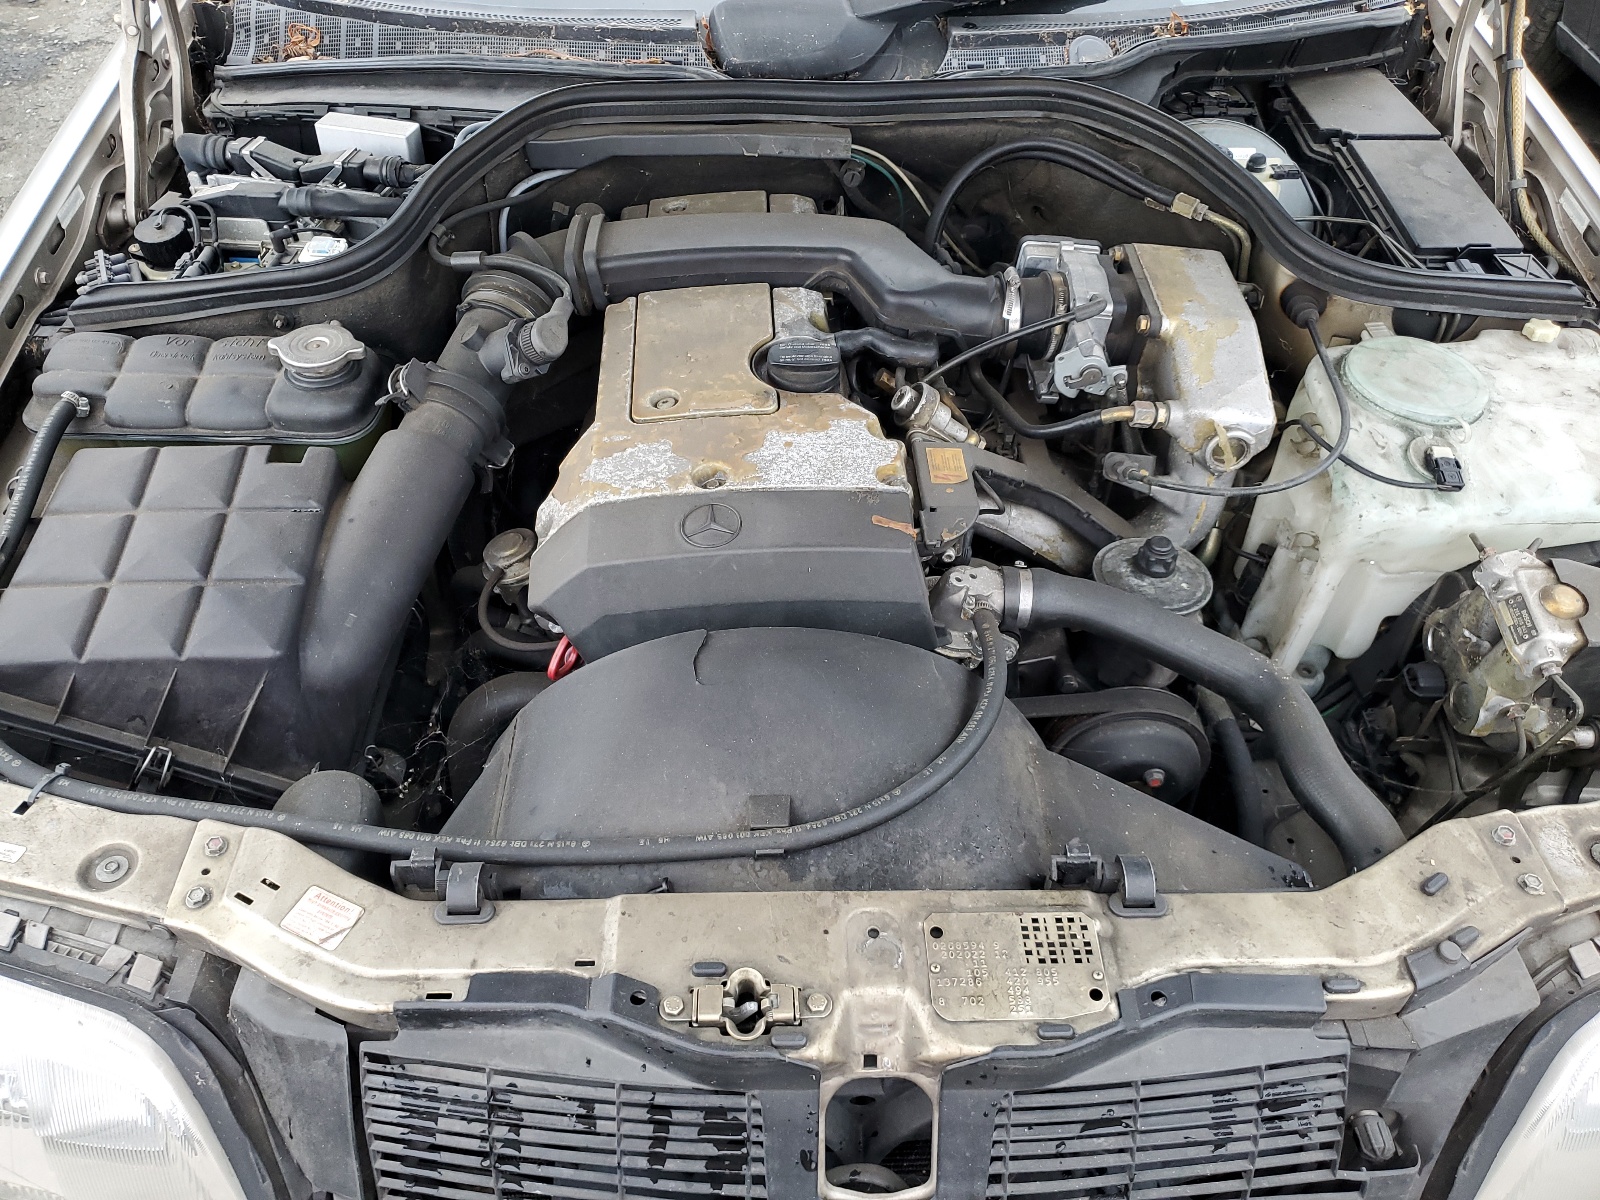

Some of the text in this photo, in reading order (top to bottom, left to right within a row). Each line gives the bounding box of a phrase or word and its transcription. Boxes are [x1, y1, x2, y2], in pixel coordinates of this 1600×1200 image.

[1521, 609, 1533, 628] BOSCH
[941, 950, 986, 959] 202022
[973, 960, 988, 968] 11
[966, 968, 989, 977] 105
[1005, 968, 1027, 977] 412
[937, 977, 983, 987] 137286
[1006, 977, 1029, 986] 420
[1007, 986, 1030, 995] 494
[961, 996, 985, 1006] 702
